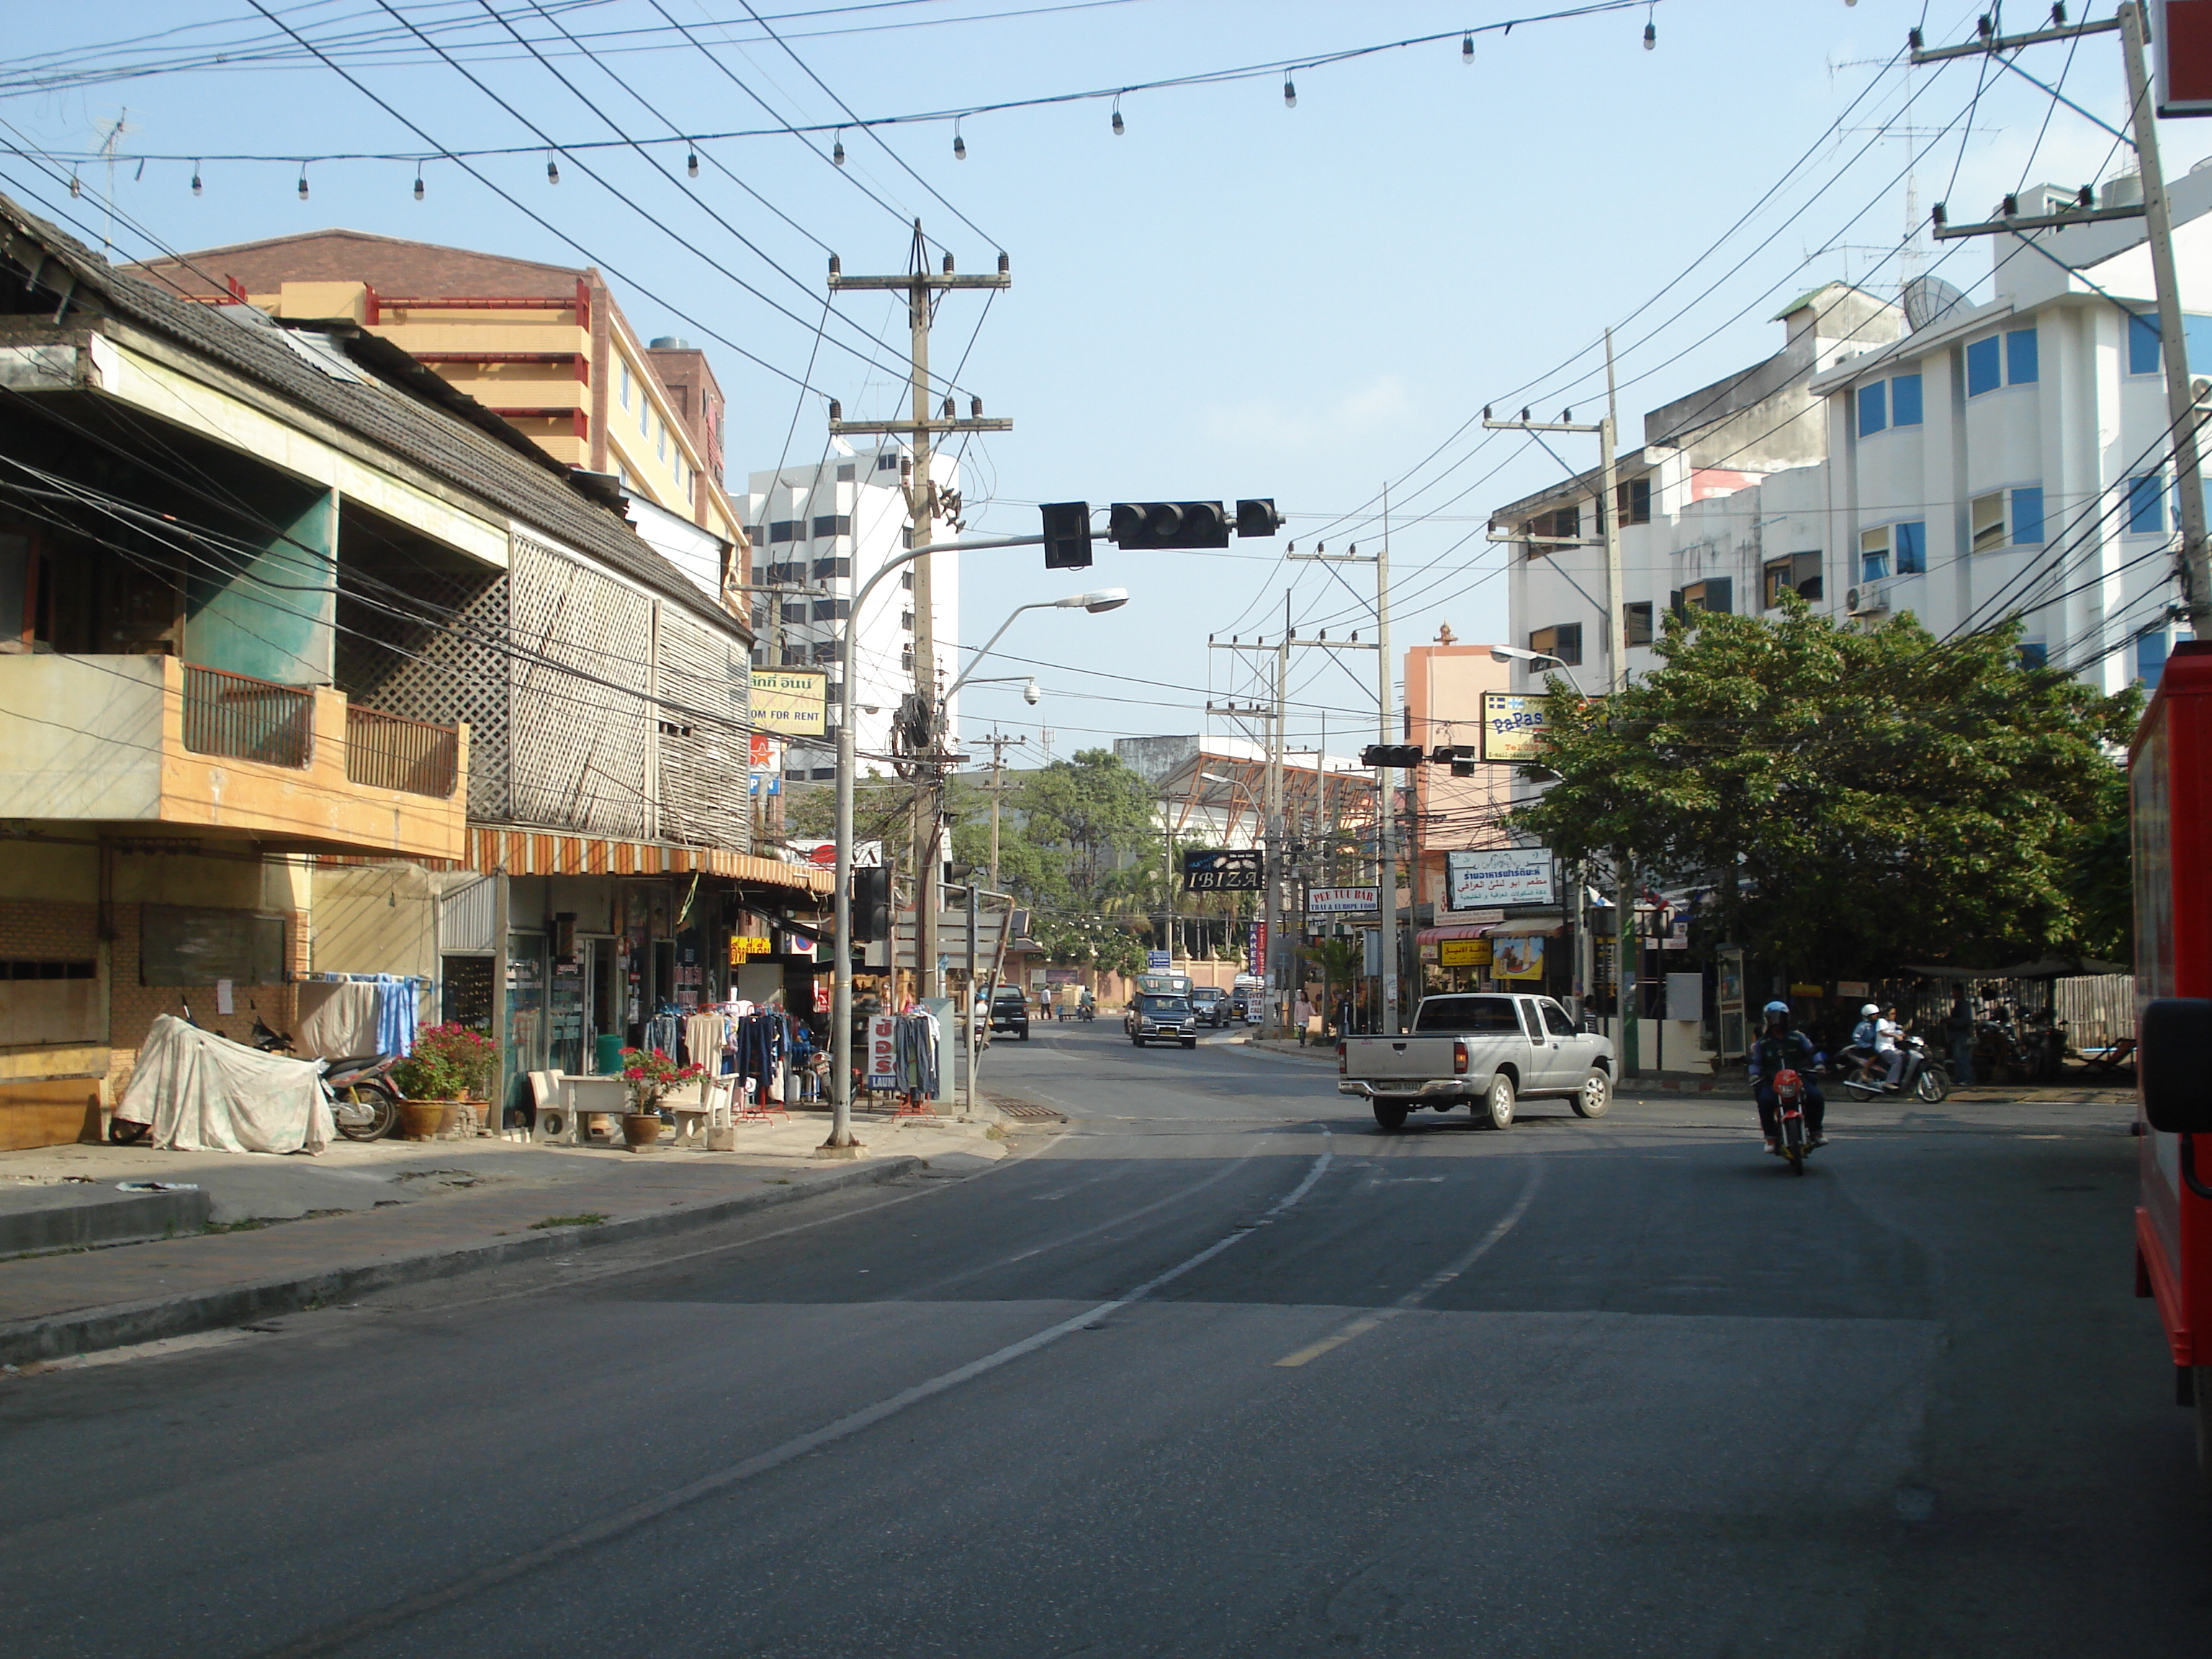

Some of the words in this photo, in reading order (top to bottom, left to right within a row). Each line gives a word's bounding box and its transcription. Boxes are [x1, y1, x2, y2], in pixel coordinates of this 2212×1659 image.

[770, 711, 789, 719] FOR
[794, 711, 820, 721] RENT
[1189, 872, 1258, 888] IBIZA
[1313, 891, 1331, 904] PEE
[1354, 890, 1373, 902] BAR
